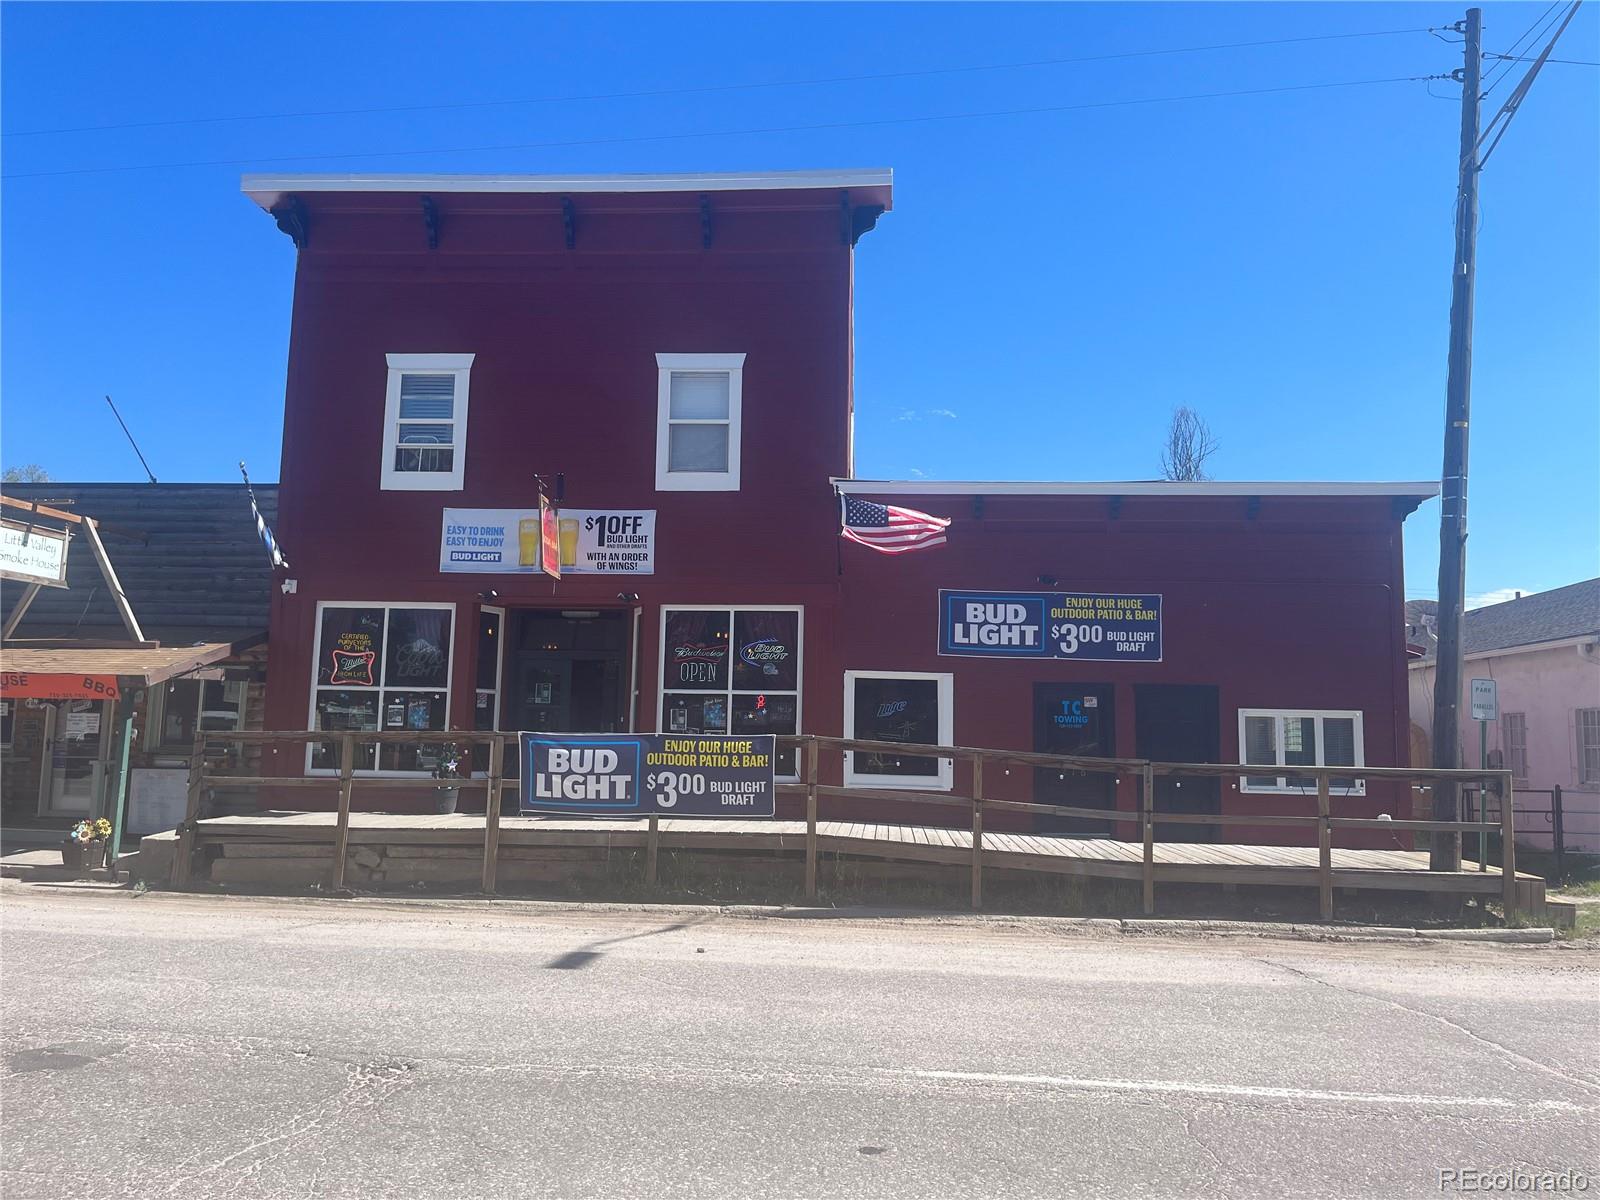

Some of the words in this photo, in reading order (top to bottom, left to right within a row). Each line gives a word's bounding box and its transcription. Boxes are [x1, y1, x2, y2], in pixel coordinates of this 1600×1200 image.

[447, 525, 467, 536] EASY
[468, 526, 478, 536] TO
[480, 526, 505, 537] DRINK
[608, 516, 643, 535] OFF
[446, 537, 466, 547] EASY
[467, 537, 478, 547] TO
[478, 537, 504, 548] ENJOY
[607, 535, 624, 544] BUD
[625, 535, 649, 544] LIGHT
[31, 537, 57, 557] Valley
[31, 555, 60, 571] House
[452, 552, 471, 561] BUD
[472, 552, 501, 562] LIGHT
[587, 552, 607, 561] WITH
[608, 552, 620, 561] AN
[621, 553, 649, 562] ORDER
[596, 562, 607, 570] OF
[608, 562, 638, 571] WINGS!
[1066, 597, 1093, 608] ENJOY
[1095, 598, 1116, 609] OUR
[1117, 599, 1143, 609] HUGE
[966, 602, 1027, 624] BUD
[1050, 607, 1096, 620] OUTDOOR
[1096, 609, 1124, 620] PATIO
[1125, 609, 1134, 620] &
[1134, 609, 1157, 621] BAR!
[954, 623, 1039, 646] LIGHT
[1106, 631, 1126, 642] BUD
[1128, 631, 1156, 642] LIGHT
[1116, 642, 1147, 653] DRAFT
[680, 662, 718, 682] OPEN
[82, 677, 117, 698] BBQ
[1054, 715, 1089, 724] TOWING
[664, 739, 697, 754] ENJOY
[698, 740, 722, 754] OUR
[723, 740, 753, 755] HUGE
[548, 748, 619, 774] BUD
[646, 752, 698, 767] OUTDOOR
[699, 754, 730, 768] PATIO
[731, 756, 741, 768] &
[742, 755, 769, 768] BAR!
[535, 773, 632, 800] LIGHT
[710, 780, 732, 793] BUD
[735, 781, 767, 794] LIGHT
[721, 794, 755, 806] DRAFT
